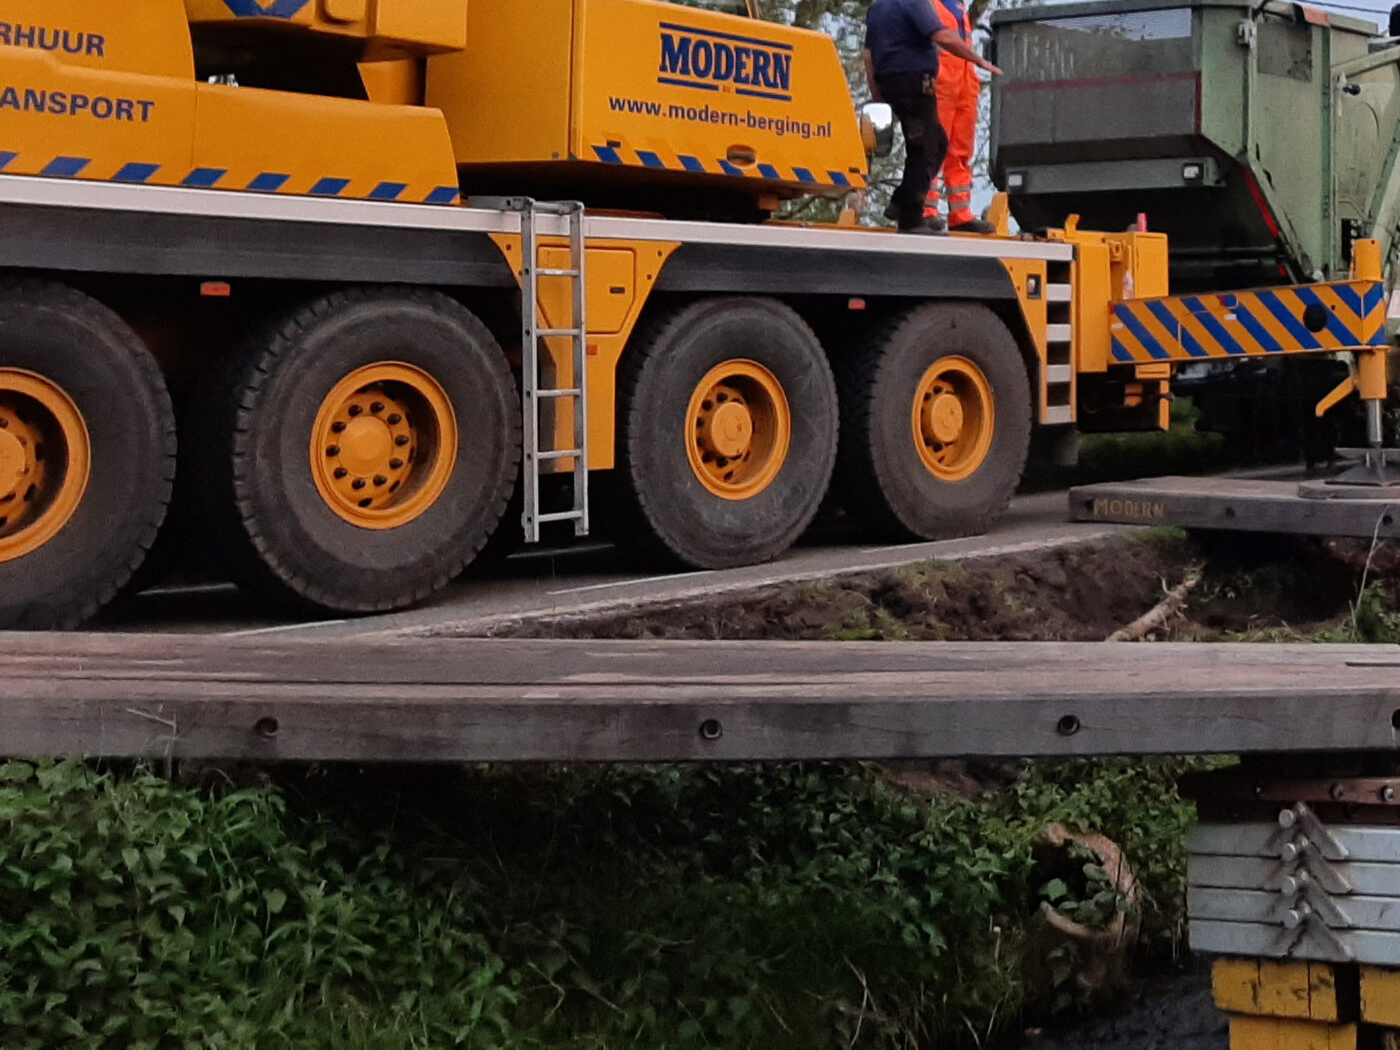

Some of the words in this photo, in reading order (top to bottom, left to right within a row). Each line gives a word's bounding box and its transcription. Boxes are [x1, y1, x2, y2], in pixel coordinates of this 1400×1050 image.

[660, 32, 792, 91] MODERN
[609, 96, 832, 139] www.modern-berging.nl
[1094, 498, 1164, 518] MODERN
